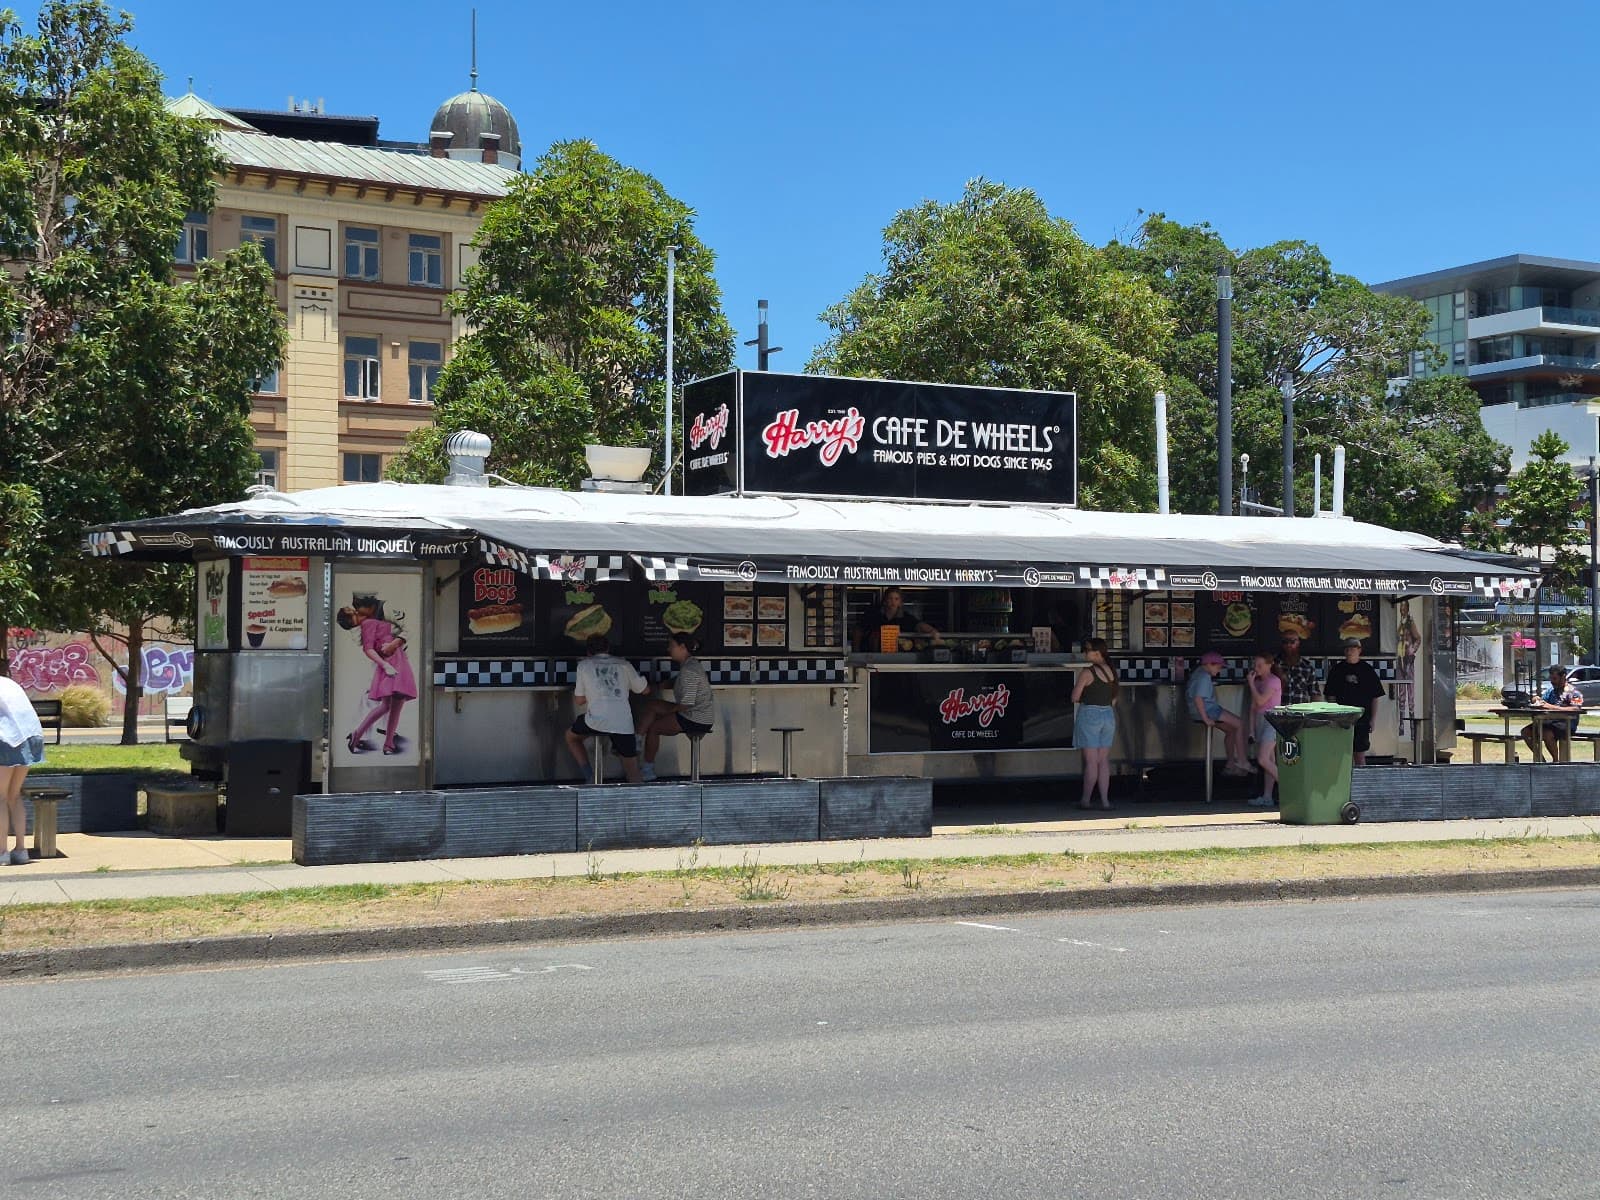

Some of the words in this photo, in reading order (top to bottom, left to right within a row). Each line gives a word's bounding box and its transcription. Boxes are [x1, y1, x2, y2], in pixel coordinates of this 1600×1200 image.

[690, 403, 730, 451] Harry's
[872, 416, 929, 447] CAFE
[936, 419, 968, 449] DE
[762, 407, 865, 467] Harry's
[873, 450, 914, 465] FAMOUS
[916, 452, 937, 466] PIES
[939, 454, 948, 466] &
[949, 454, 972, 468] HOT
[973, 455, 1002, 469] DOGS
[1003, 456, 1029, 470] SINCE
[1030, 457, 1053, 471] 1945
[213, 535, 276, 550] FAMOUSLY
[357, 538, 417, 554] UNIQUELY
[473, 567, 516, 586] Chilli
[786, 565, 840, 579] FAMOUSLY
[904, 567, 951, 582] UNIQUELY
[955, 568, 994, 582] HARRY'S
[1240, 575, 1283, 588] FAMOUSLY
[1334, 578, 1372, 590] UNIQUELY
[1375, 579, 1407, 591] HARRY'S
[474, 584, 518, 604] Dogs
[247, 608, 276, 620] Special
[940, 683, 1010, 728] Harry's
[951, 730, 966, 739] CAFE
[967, 730, 976, 739] DE
